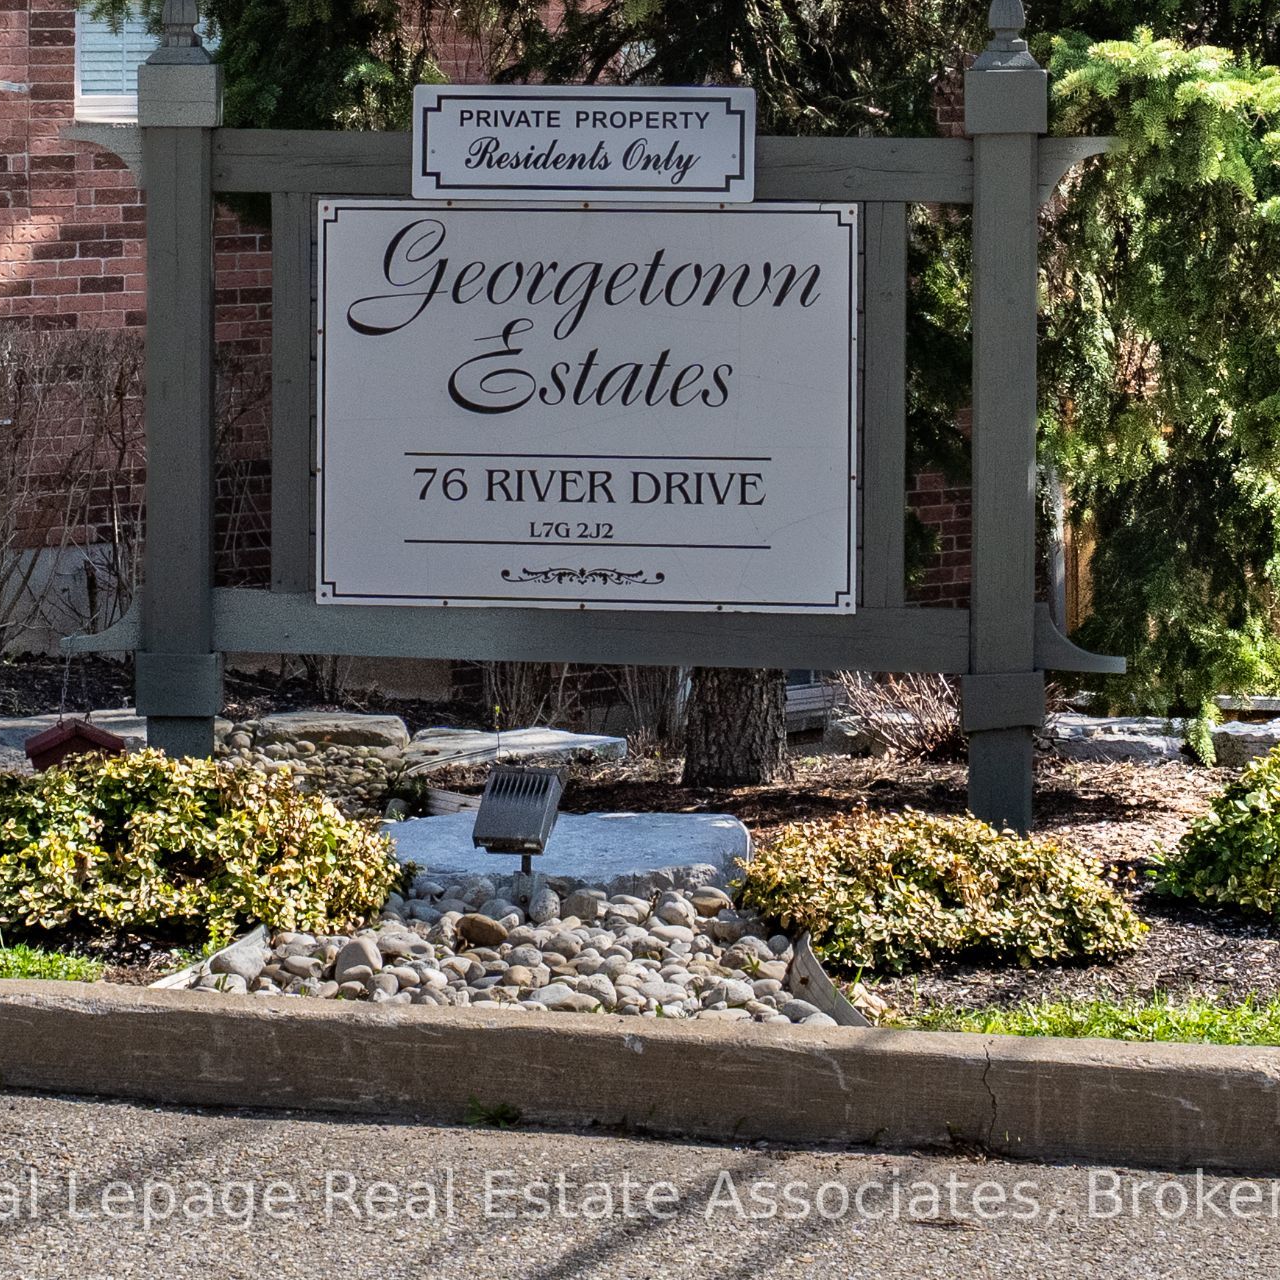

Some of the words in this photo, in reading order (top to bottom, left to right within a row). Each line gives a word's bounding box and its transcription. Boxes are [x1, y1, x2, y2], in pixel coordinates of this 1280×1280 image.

[459, 110, 561, 128] PRIVATE
[575, 111, 710, 129] PROPERTY
[464, 136, 612, 171] Residents
[622, 137, 701, 185] Only
[346, 218, 821, 340] Georgetown
[447, 317, 734, 415] Estates
[413, 467, 469, 502] 76
[485, 469, 617, 504] RIVER
[629, 471, 767, 506] DRIVE
[529, 521, 571, 539] L7G
[576, 522, 614, 539] 2J2
